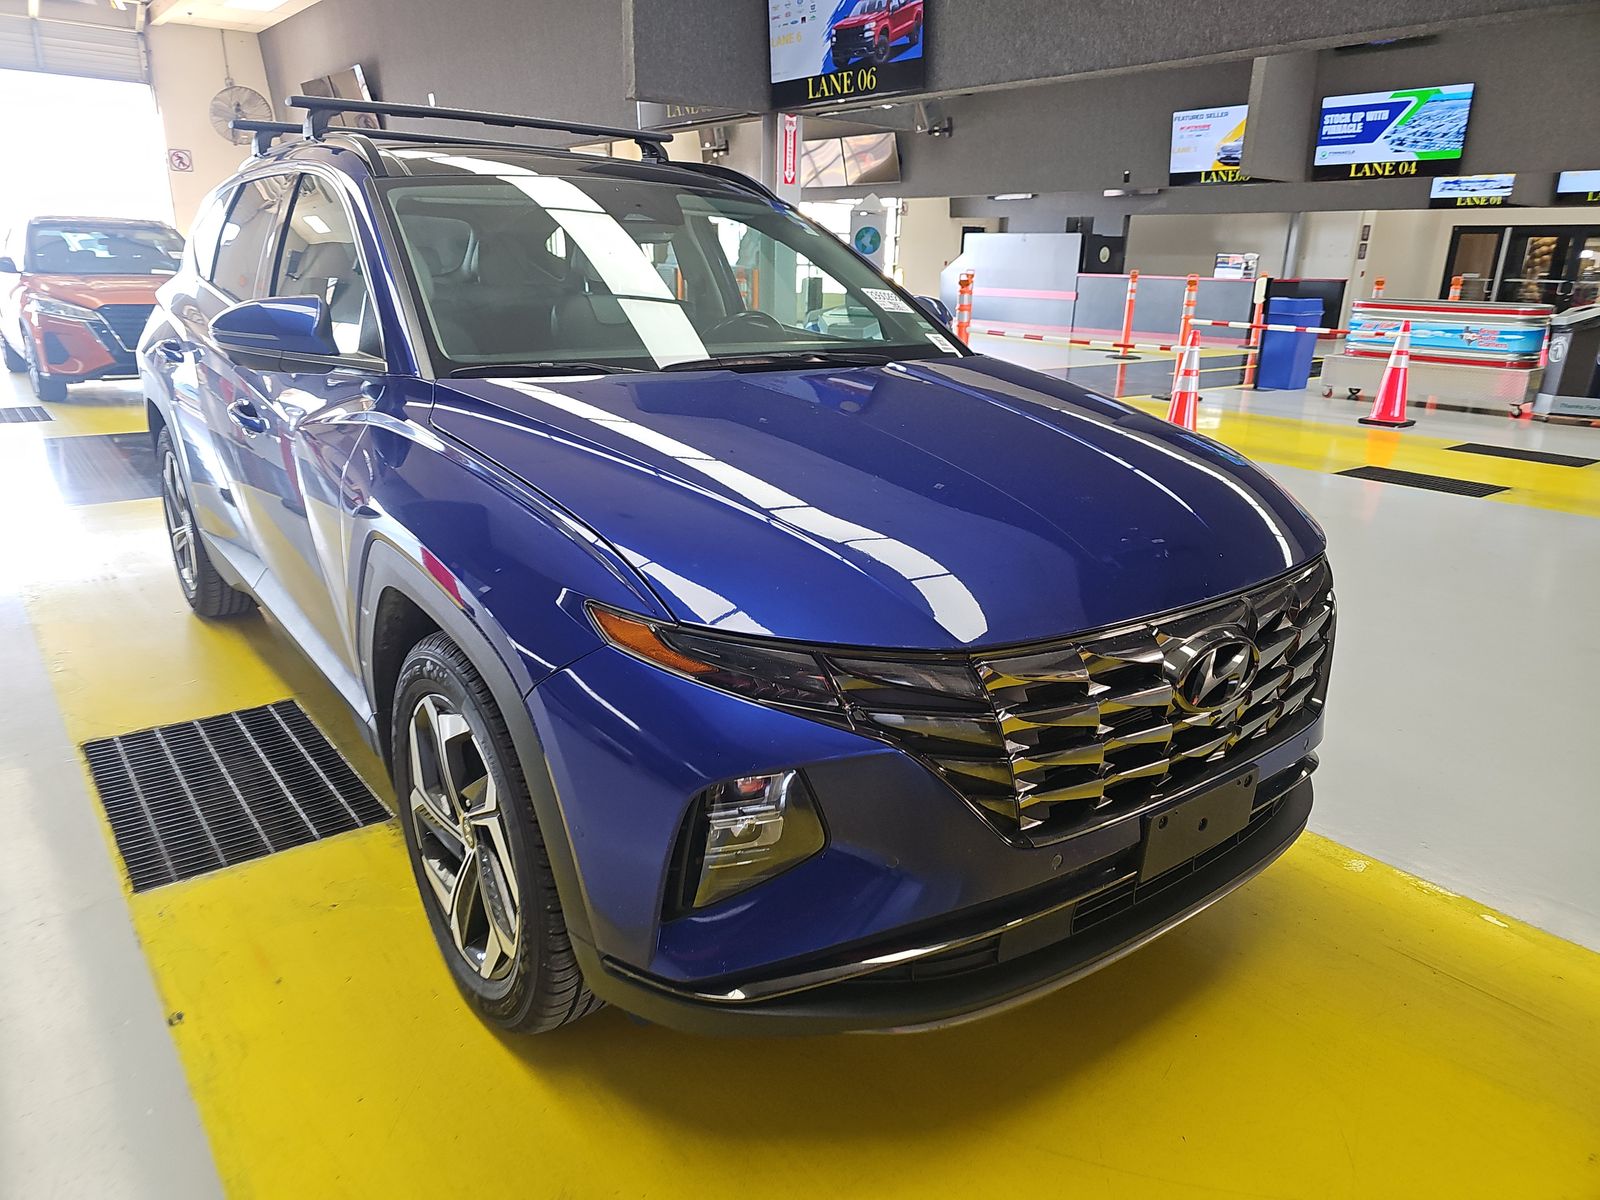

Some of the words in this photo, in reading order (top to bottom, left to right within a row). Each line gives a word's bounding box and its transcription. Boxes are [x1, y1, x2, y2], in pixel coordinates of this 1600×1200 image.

[808, 70, 854, 100] LANE
[857, 67, 877, 91] 06
[1174, 114, 1204, 122] FEATURED
[1205, 111, 1229, 120] SELLER
[1323, 112, 1352, 125] STOCK
[1352, 111, 1365, 123] UP
[1365, 109, 1390, 122] WITH
[1321, 122, 1364, 136] PINNACLE
[1200, 169, 1236, 184] LANE
[1349, 162, 1396, 177] LANE
[1398, 161, 1418, 175] 04
[1456, 196, 1489, 206] LANE
